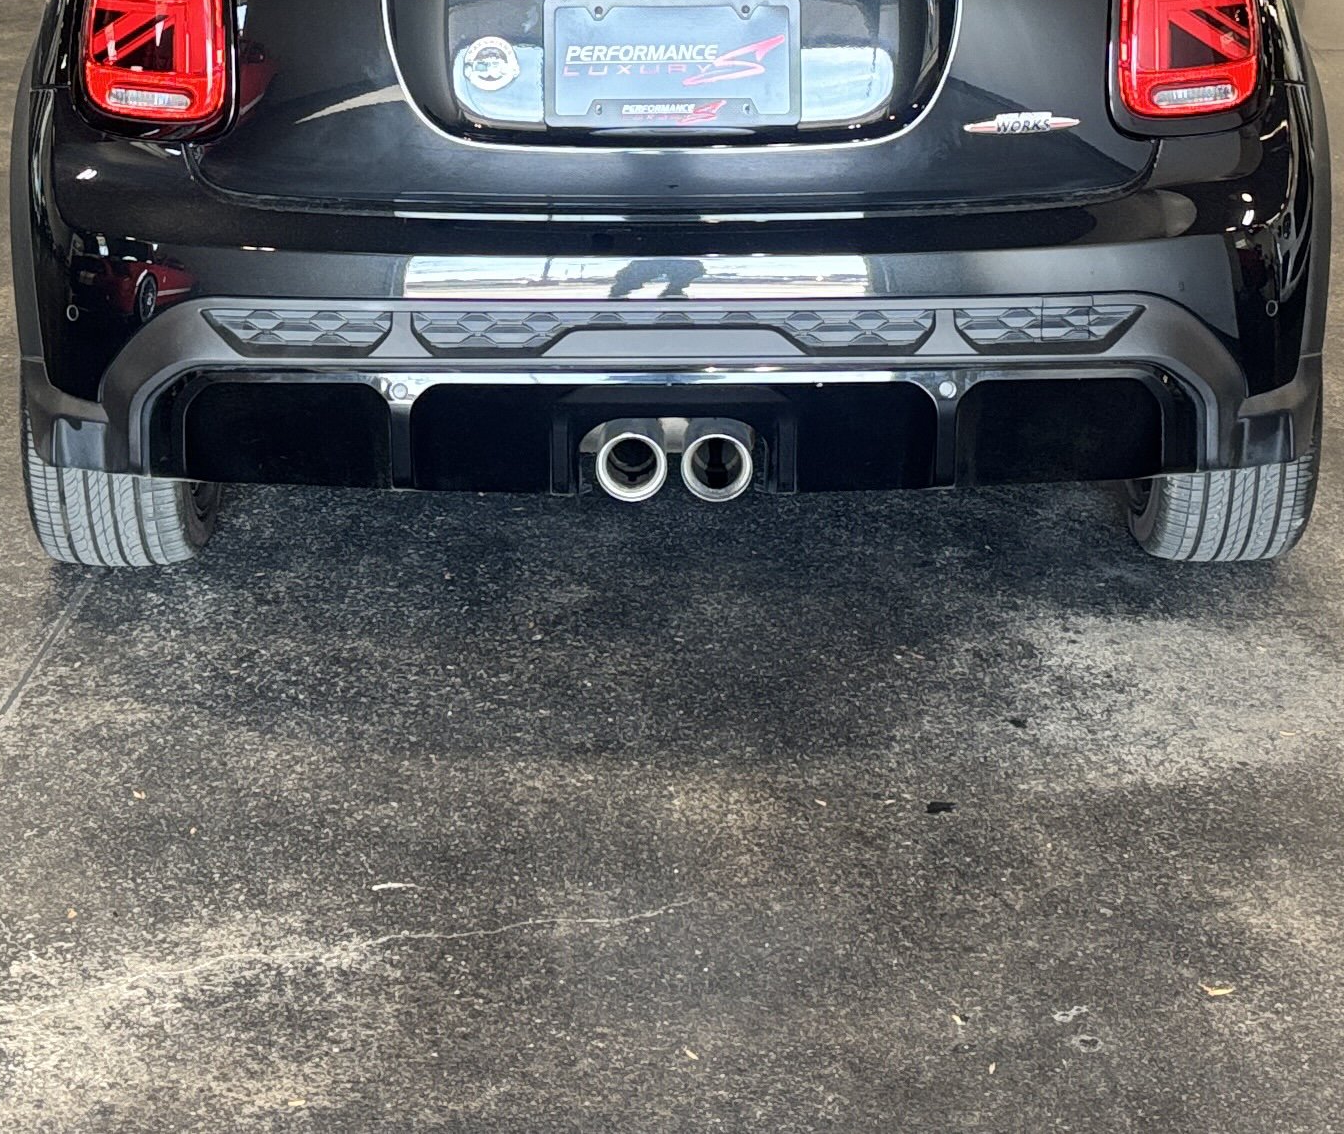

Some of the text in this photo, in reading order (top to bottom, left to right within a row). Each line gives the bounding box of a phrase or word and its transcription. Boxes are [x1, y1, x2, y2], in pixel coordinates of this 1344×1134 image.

[566, 44, 719, 62] PERFORMANCE
[562, 63, 716, 77] LUXURY
[621, 104, 696, 114] PERFORMANCE
[997, 118, 1051, 133] WORKS
